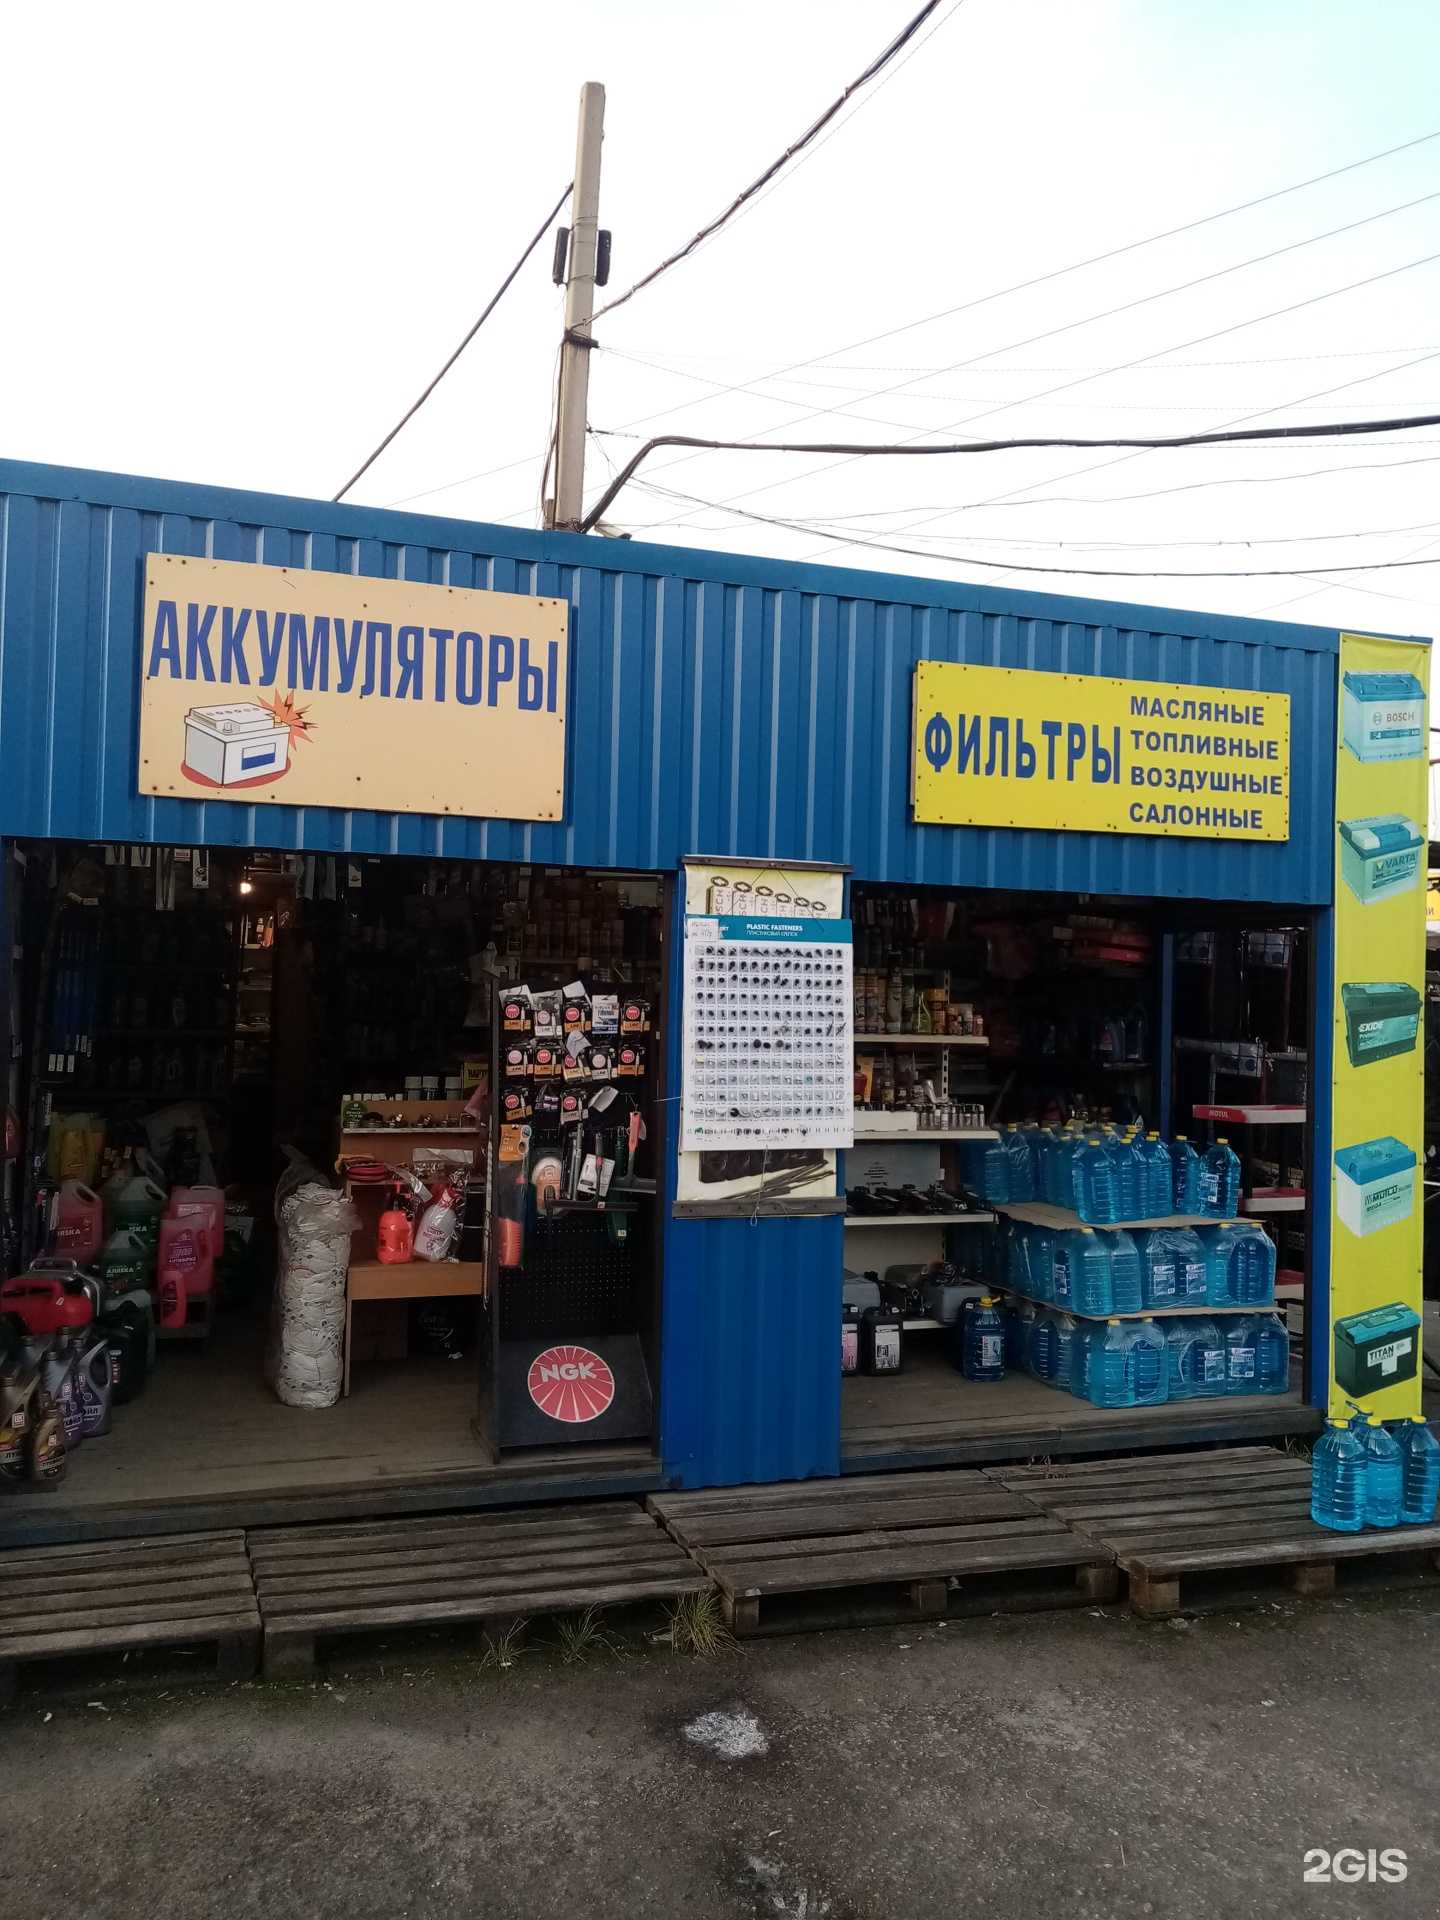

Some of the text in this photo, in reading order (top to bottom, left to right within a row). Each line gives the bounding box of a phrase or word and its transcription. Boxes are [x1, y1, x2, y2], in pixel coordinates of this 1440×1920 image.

[148, 600, 558, 713] АККУМУЛЯТОРЫ
[1130, 696, 1265, 726] МАСЛЯНЫЕ
[1386, 712, 1415, 722] BOSCH
[925, 712, 1121, 785] ФИЛЬТРЫ
[1130, 730, 1279, 760] ТОПЛИВНЫЕ
[1131, 766, 1283, 796] ВОЗДУШНЫЕ
[1129, 803, 1264, 829] САЛОННЫЕ
[1385, 853, 1416, 869] VARTA
[746, 923, 804, 932] PLASTIC FASTENERS
[1358, 1020, 1385, 1033] EXIDE
[1369, 1344, 1394, 1361] TITAN
[540, 1361, 598, 1383] NGK
